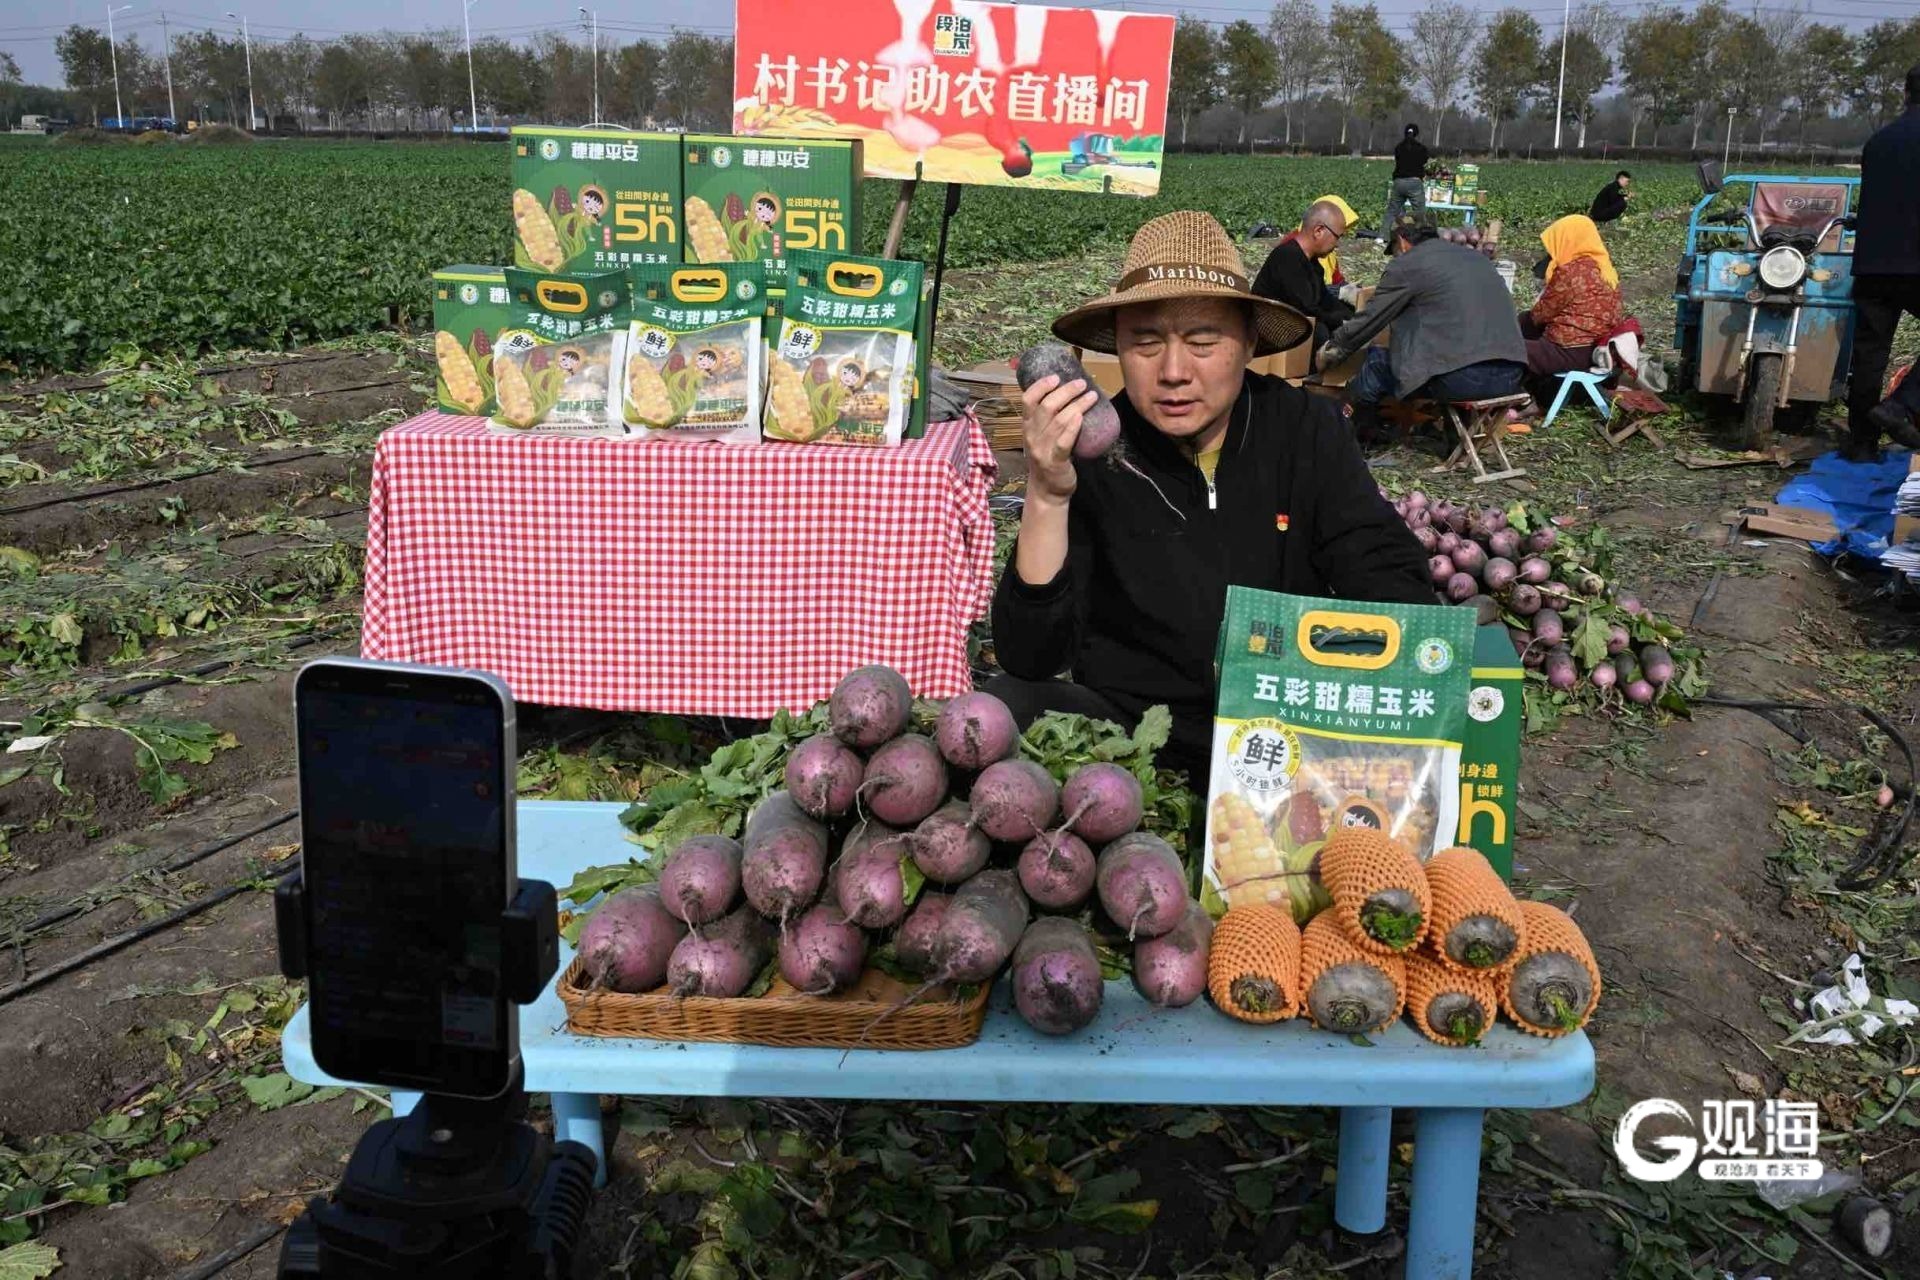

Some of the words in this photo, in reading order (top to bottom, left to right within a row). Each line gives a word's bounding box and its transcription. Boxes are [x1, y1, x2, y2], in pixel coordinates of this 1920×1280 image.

[753, 53, 1150, 130] 村书记助农直播间
[615, 203, 676, 243] 5h
[785, 210, 846, 250] 5h
[800, 295, 897, 319] 五彩甜糯玉米
[645, 331, 667, 350] 鲜
[790, 330, 814, 349] 鲜
[1253, 673, 1436, 718] 五彩甜糯玉米
[1279, 707, 1411, 731] XINXIANYUMI
[1243, 733, 1286, 771] 鲜
